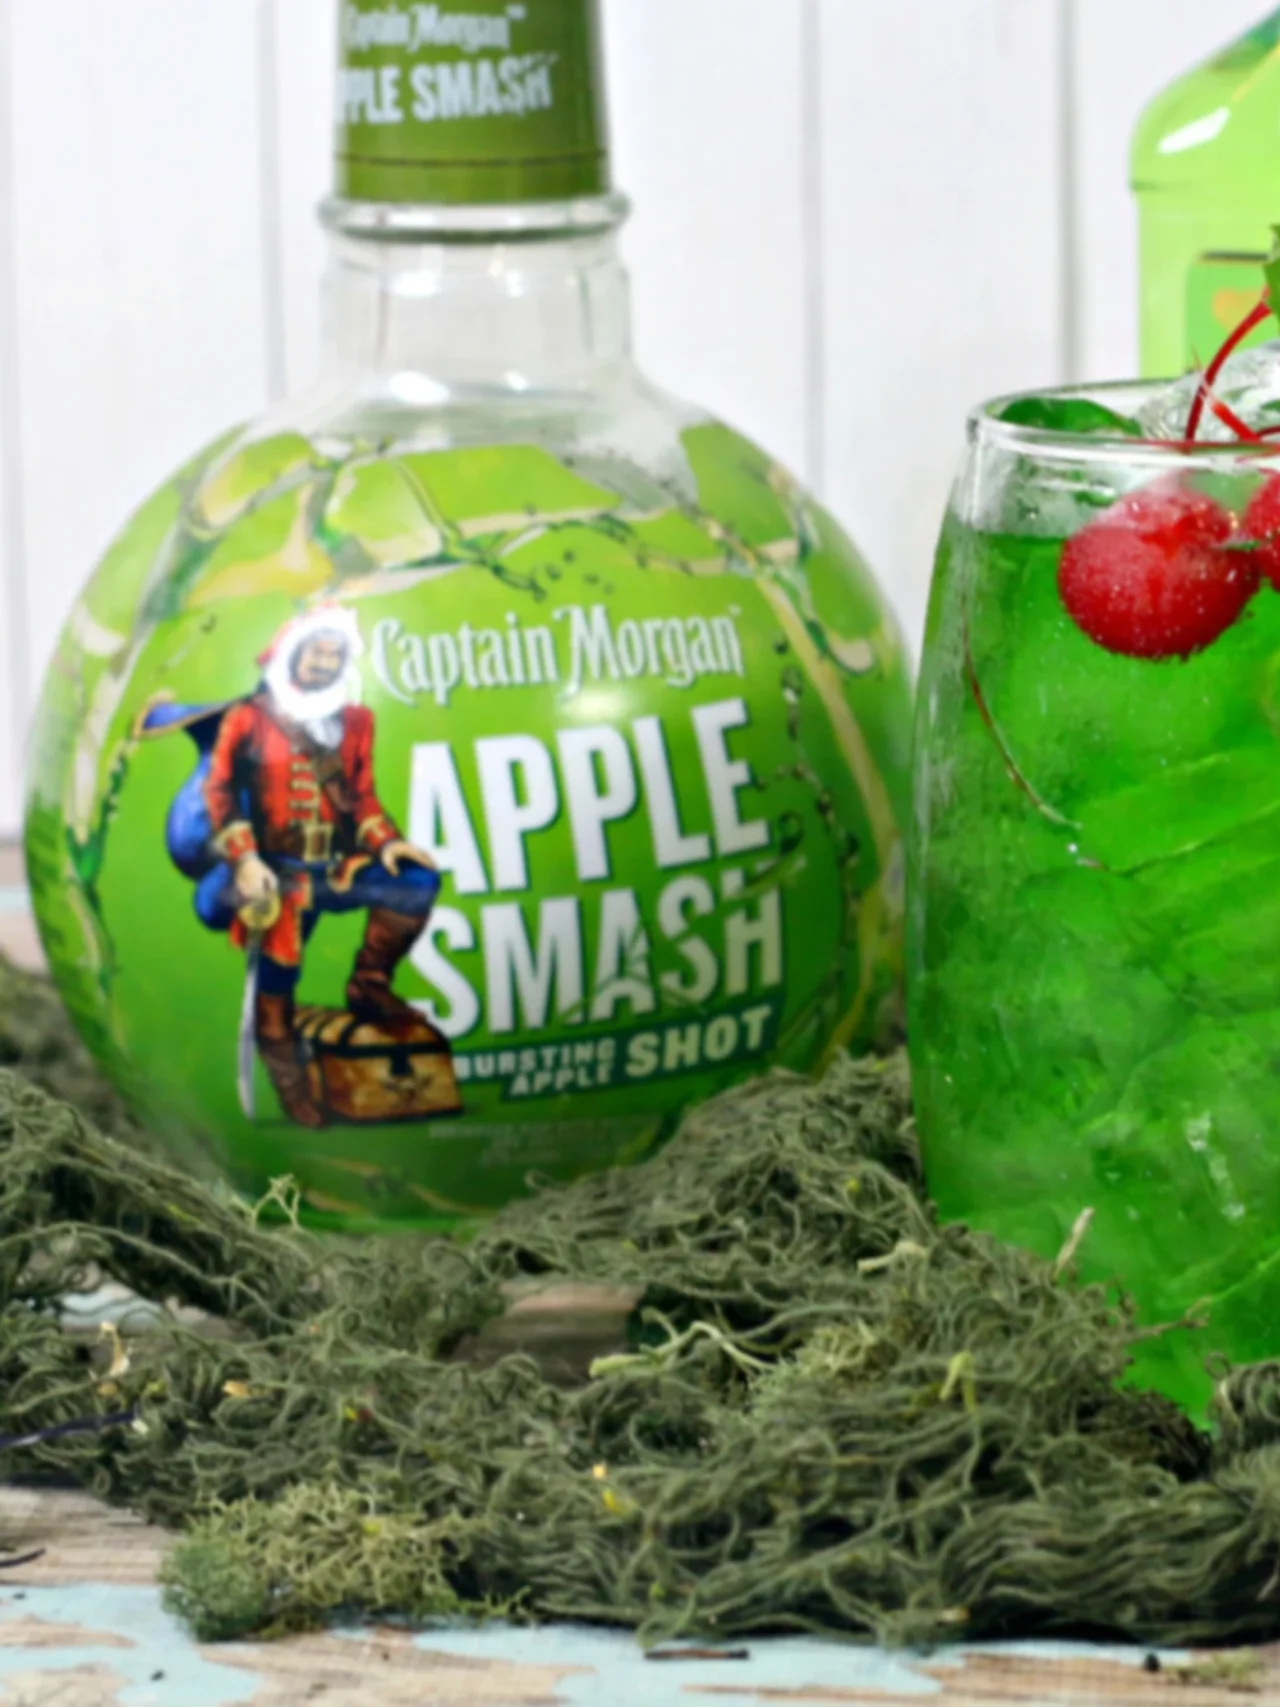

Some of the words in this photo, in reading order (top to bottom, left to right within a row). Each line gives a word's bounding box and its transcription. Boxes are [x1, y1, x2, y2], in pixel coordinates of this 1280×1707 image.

[411, 55, 554, 121] SMASH
[371, 610, 559, 706] Captain
[552, 602, 745, 700] Morgan
[406, 697, 770, 895] APPLE
[406, 861, 784, 1041] SMASH
[509, 1060, 614, 1097] APPLE
[625, 1004, 772, 1079] SHOT
